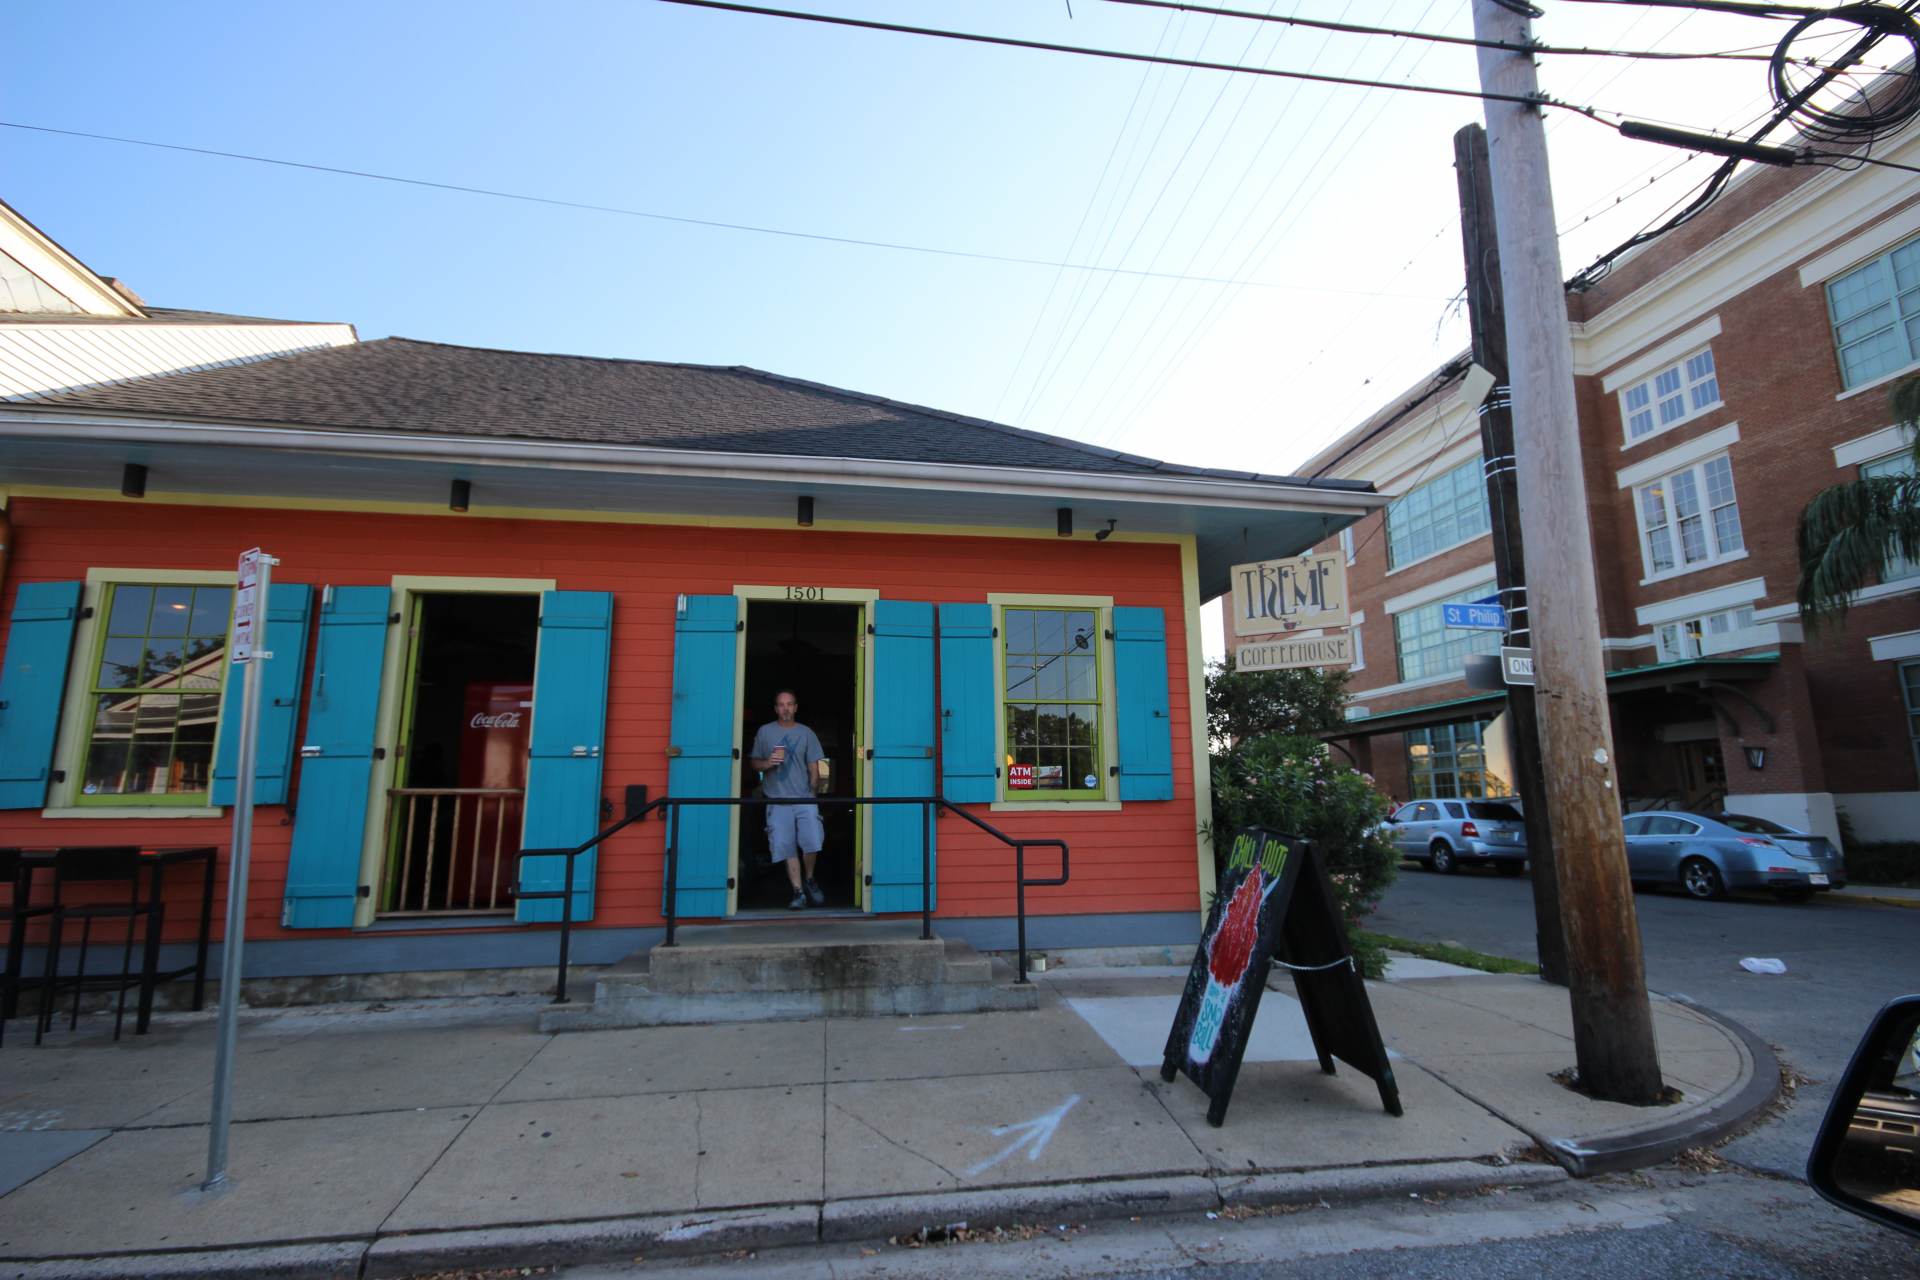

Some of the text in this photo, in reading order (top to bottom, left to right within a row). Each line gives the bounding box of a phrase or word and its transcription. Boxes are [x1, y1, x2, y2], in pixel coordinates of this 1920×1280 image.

[786, 586, 824, 600] 1501
[1447, 607, 1501, 627] St Philip
[1241, 640, 1348, 667] COFFEEHOUSE
[1010, 767, 1031, 776] ATM
